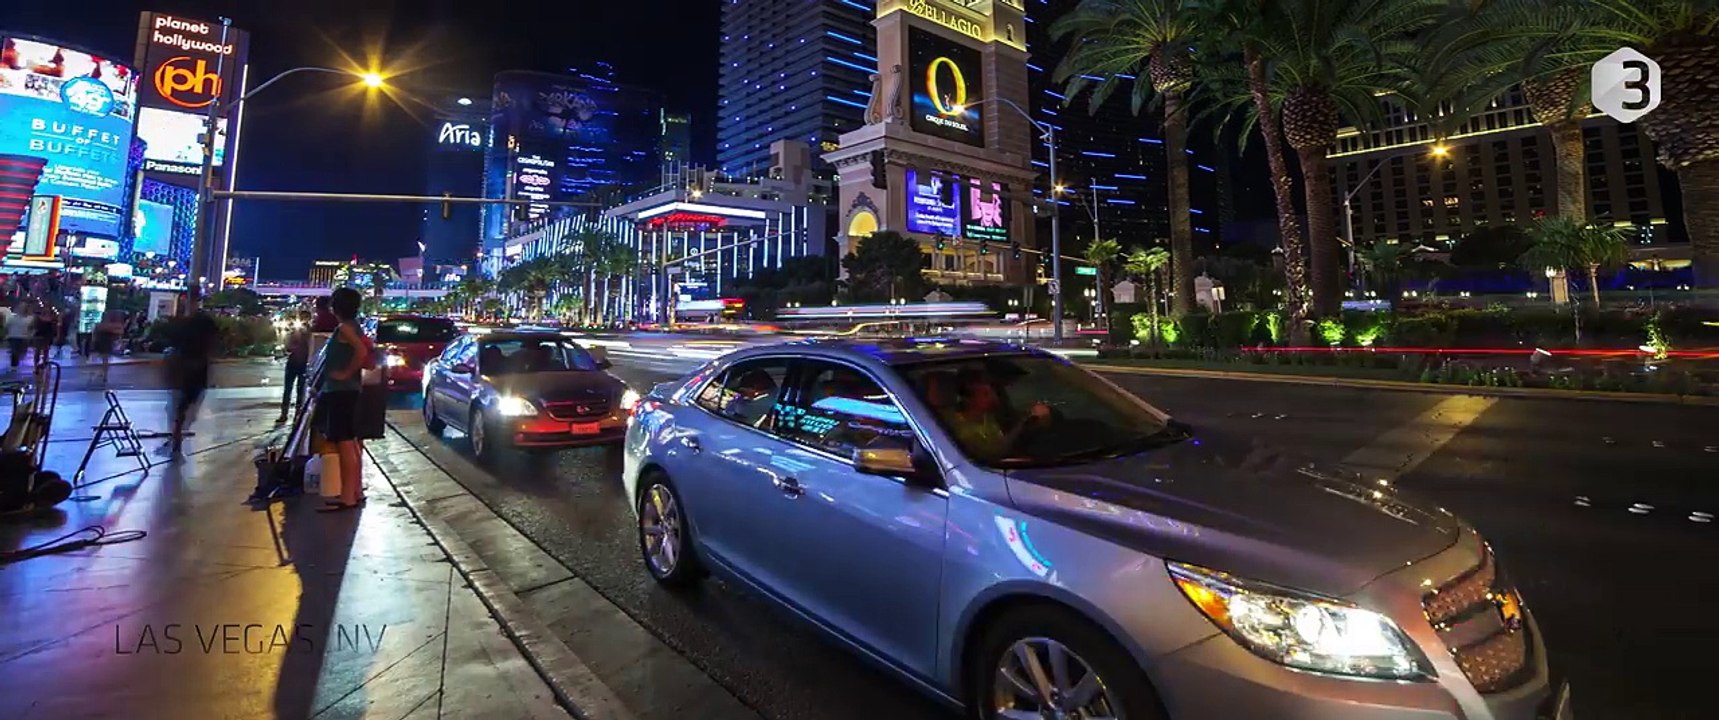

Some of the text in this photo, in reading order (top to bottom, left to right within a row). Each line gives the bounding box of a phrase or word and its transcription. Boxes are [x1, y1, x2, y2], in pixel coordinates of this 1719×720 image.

[155, 17, 209, 34] planet
[153, 31, 233, 54] hollywood
[31, 118, 120, 145] BUFFET
[438, 122, 481, 147] Aria
